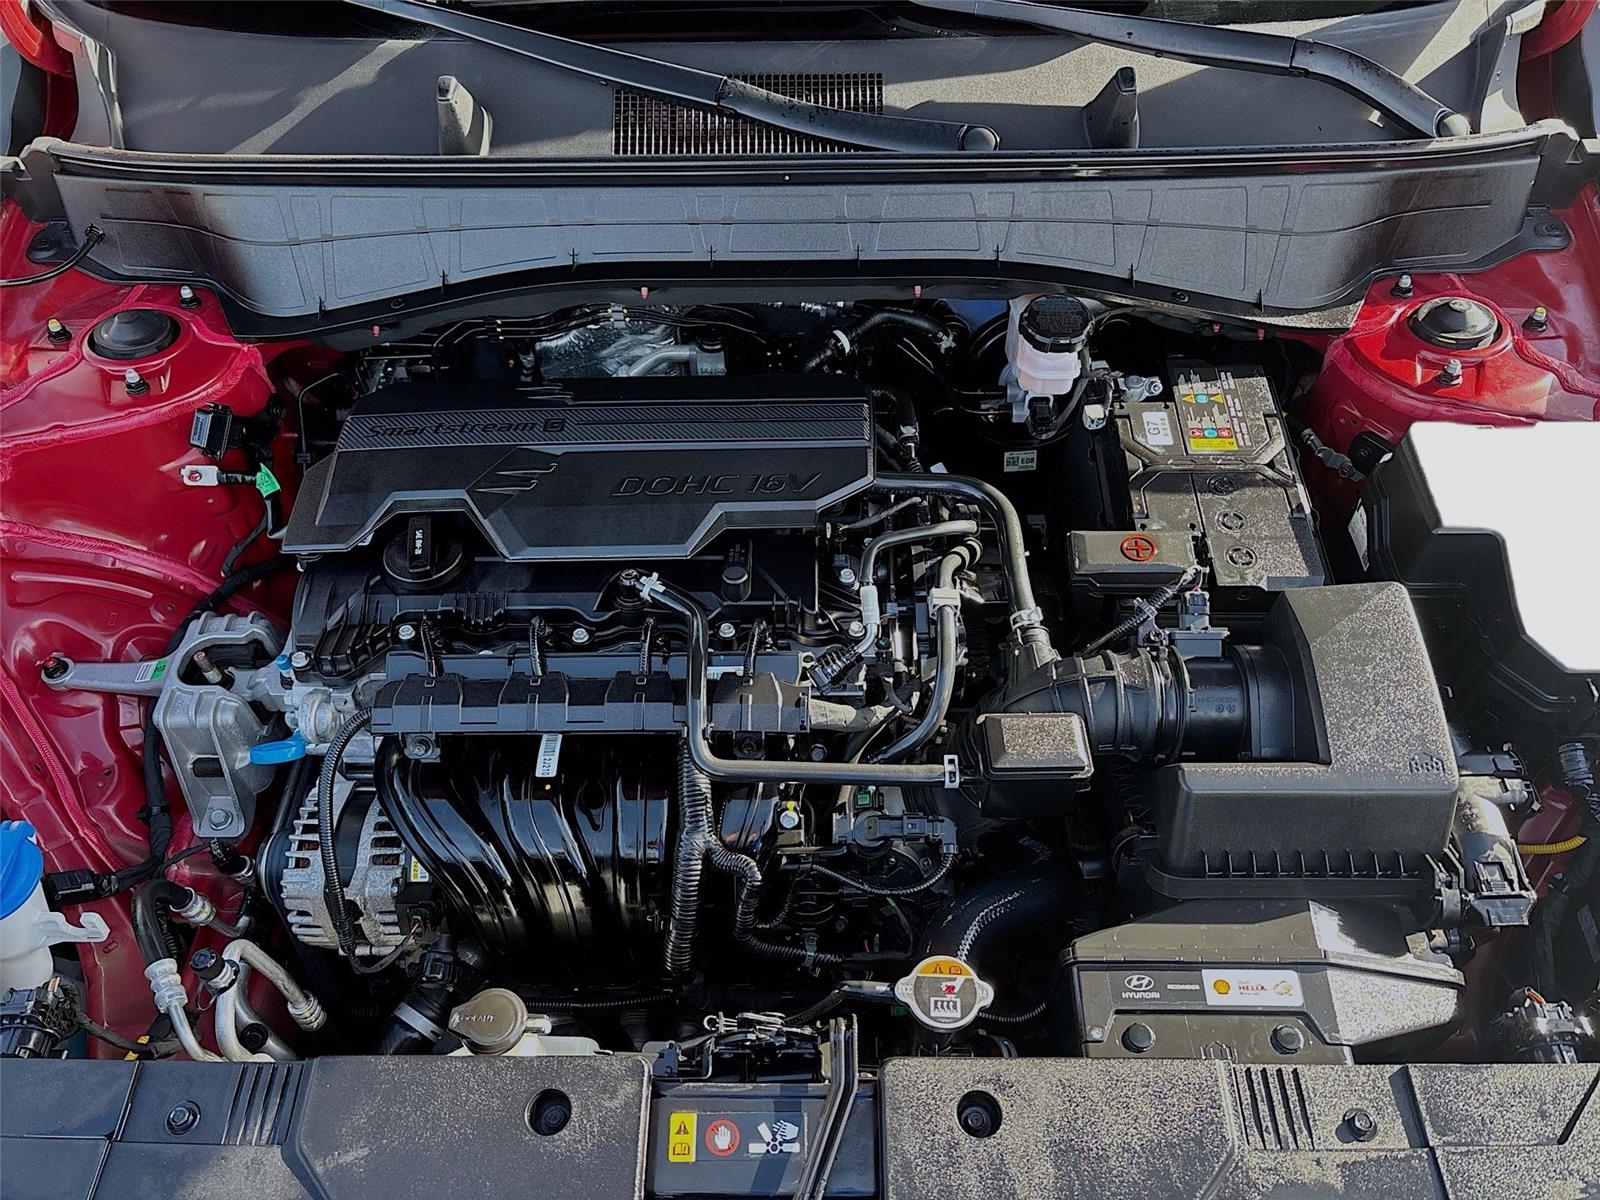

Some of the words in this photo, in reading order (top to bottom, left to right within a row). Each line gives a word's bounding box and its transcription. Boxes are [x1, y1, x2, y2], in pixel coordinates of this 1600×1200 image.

[363, 420, 537, 438] Smartstream
[1147, 420, 1161, 437] G7
[611, 474, 740, 496] DOHC
[748, 472, 823, 494] 16V
[1121, 991, 1161, 999] HYUNDAI
[1238, 984, 1268, 992] HELIX
